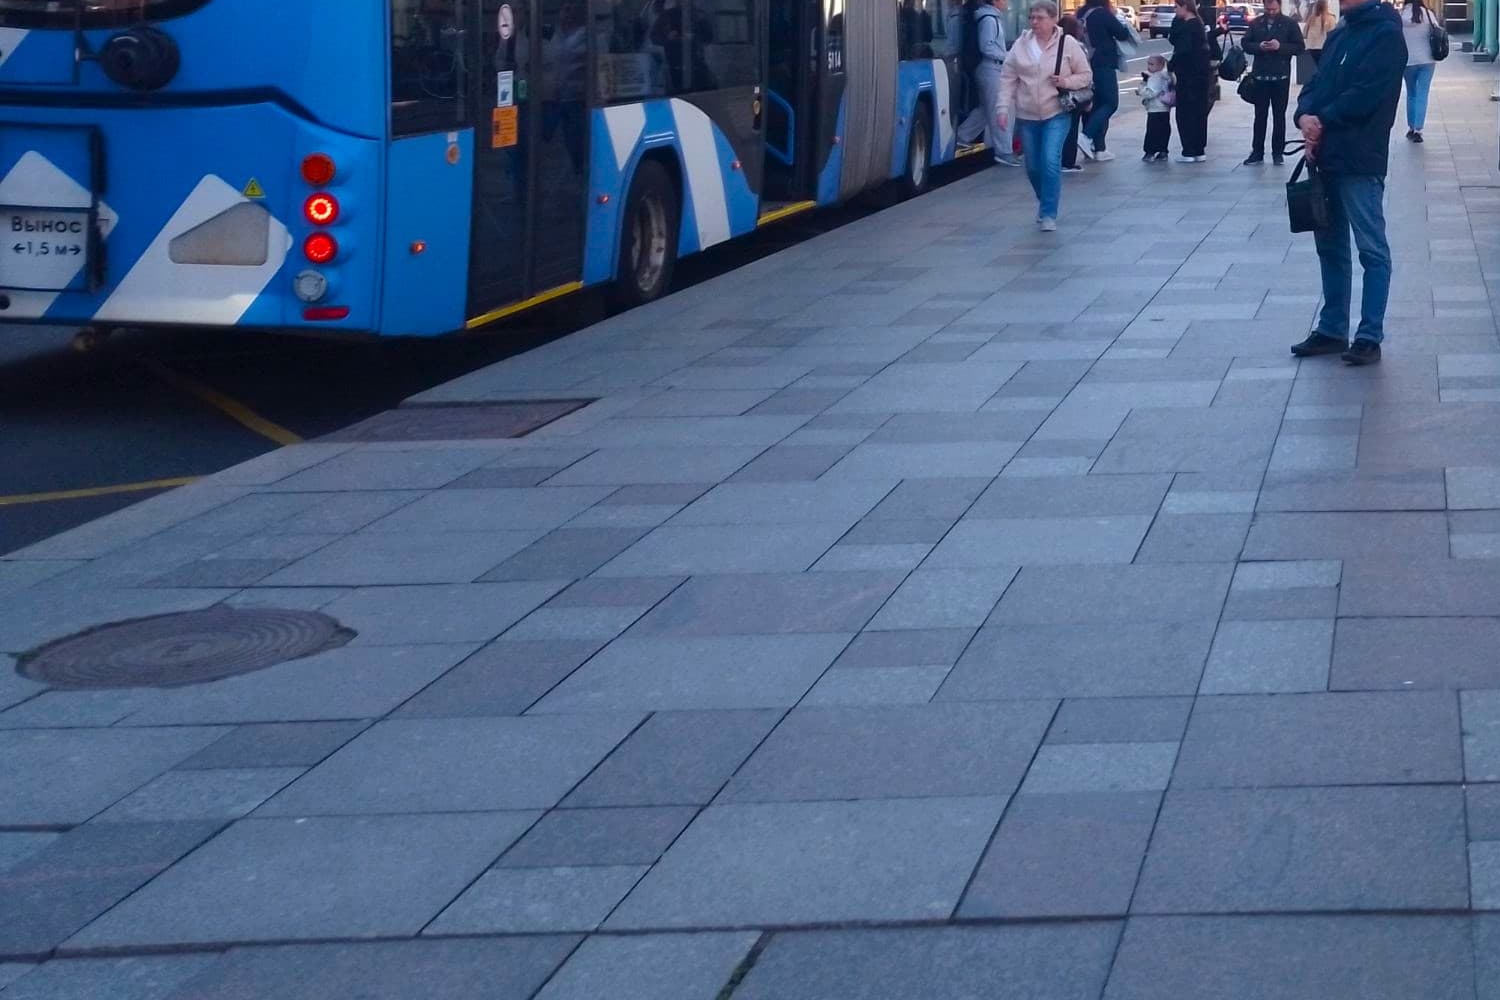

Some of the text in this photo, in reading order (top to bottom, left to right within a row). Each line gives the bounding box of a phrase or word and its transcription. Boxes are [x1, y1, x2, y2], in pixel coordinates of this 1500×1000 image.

[12, 216, 81, 233] Вынос
[27, 241, 67, 256] 1,5 м
